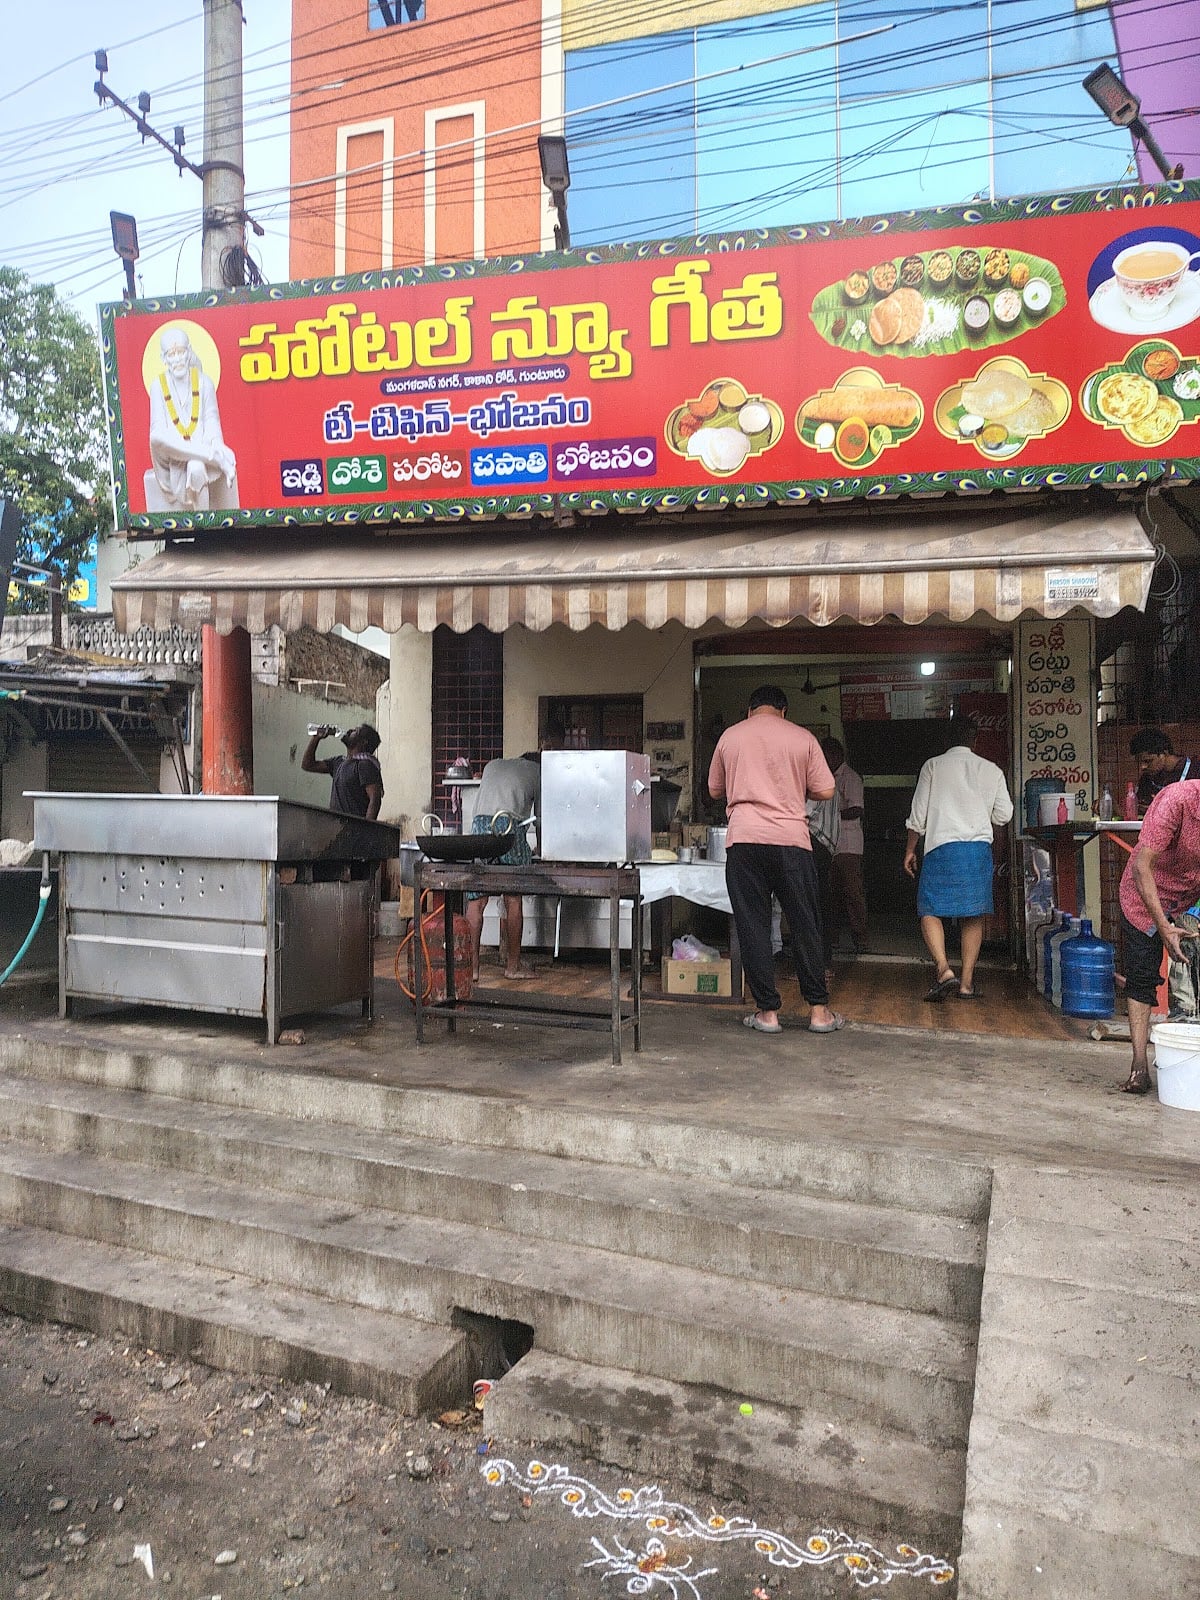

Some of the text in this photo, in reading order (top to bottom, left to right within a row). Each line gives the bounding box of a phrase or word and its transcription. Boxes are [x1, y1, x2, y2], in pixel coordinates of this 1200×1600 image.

[239, 259, 784, 383] హోటల్ న్యూ గీత
[282, 463, 323, 494] ఇడ్లి
[392, 451, 463, 482] పరోట
[472, 450, 548, 478] చపాతి
[555, 442, 655, 476] భోజనం
[1026, 676, 1076, 694] చపాతి
[1028, 697, 1083, 716] పరోట
[1028, 721, 1069, 743] పూరి
[1026, 741, 1077, 762] కిచిడి
